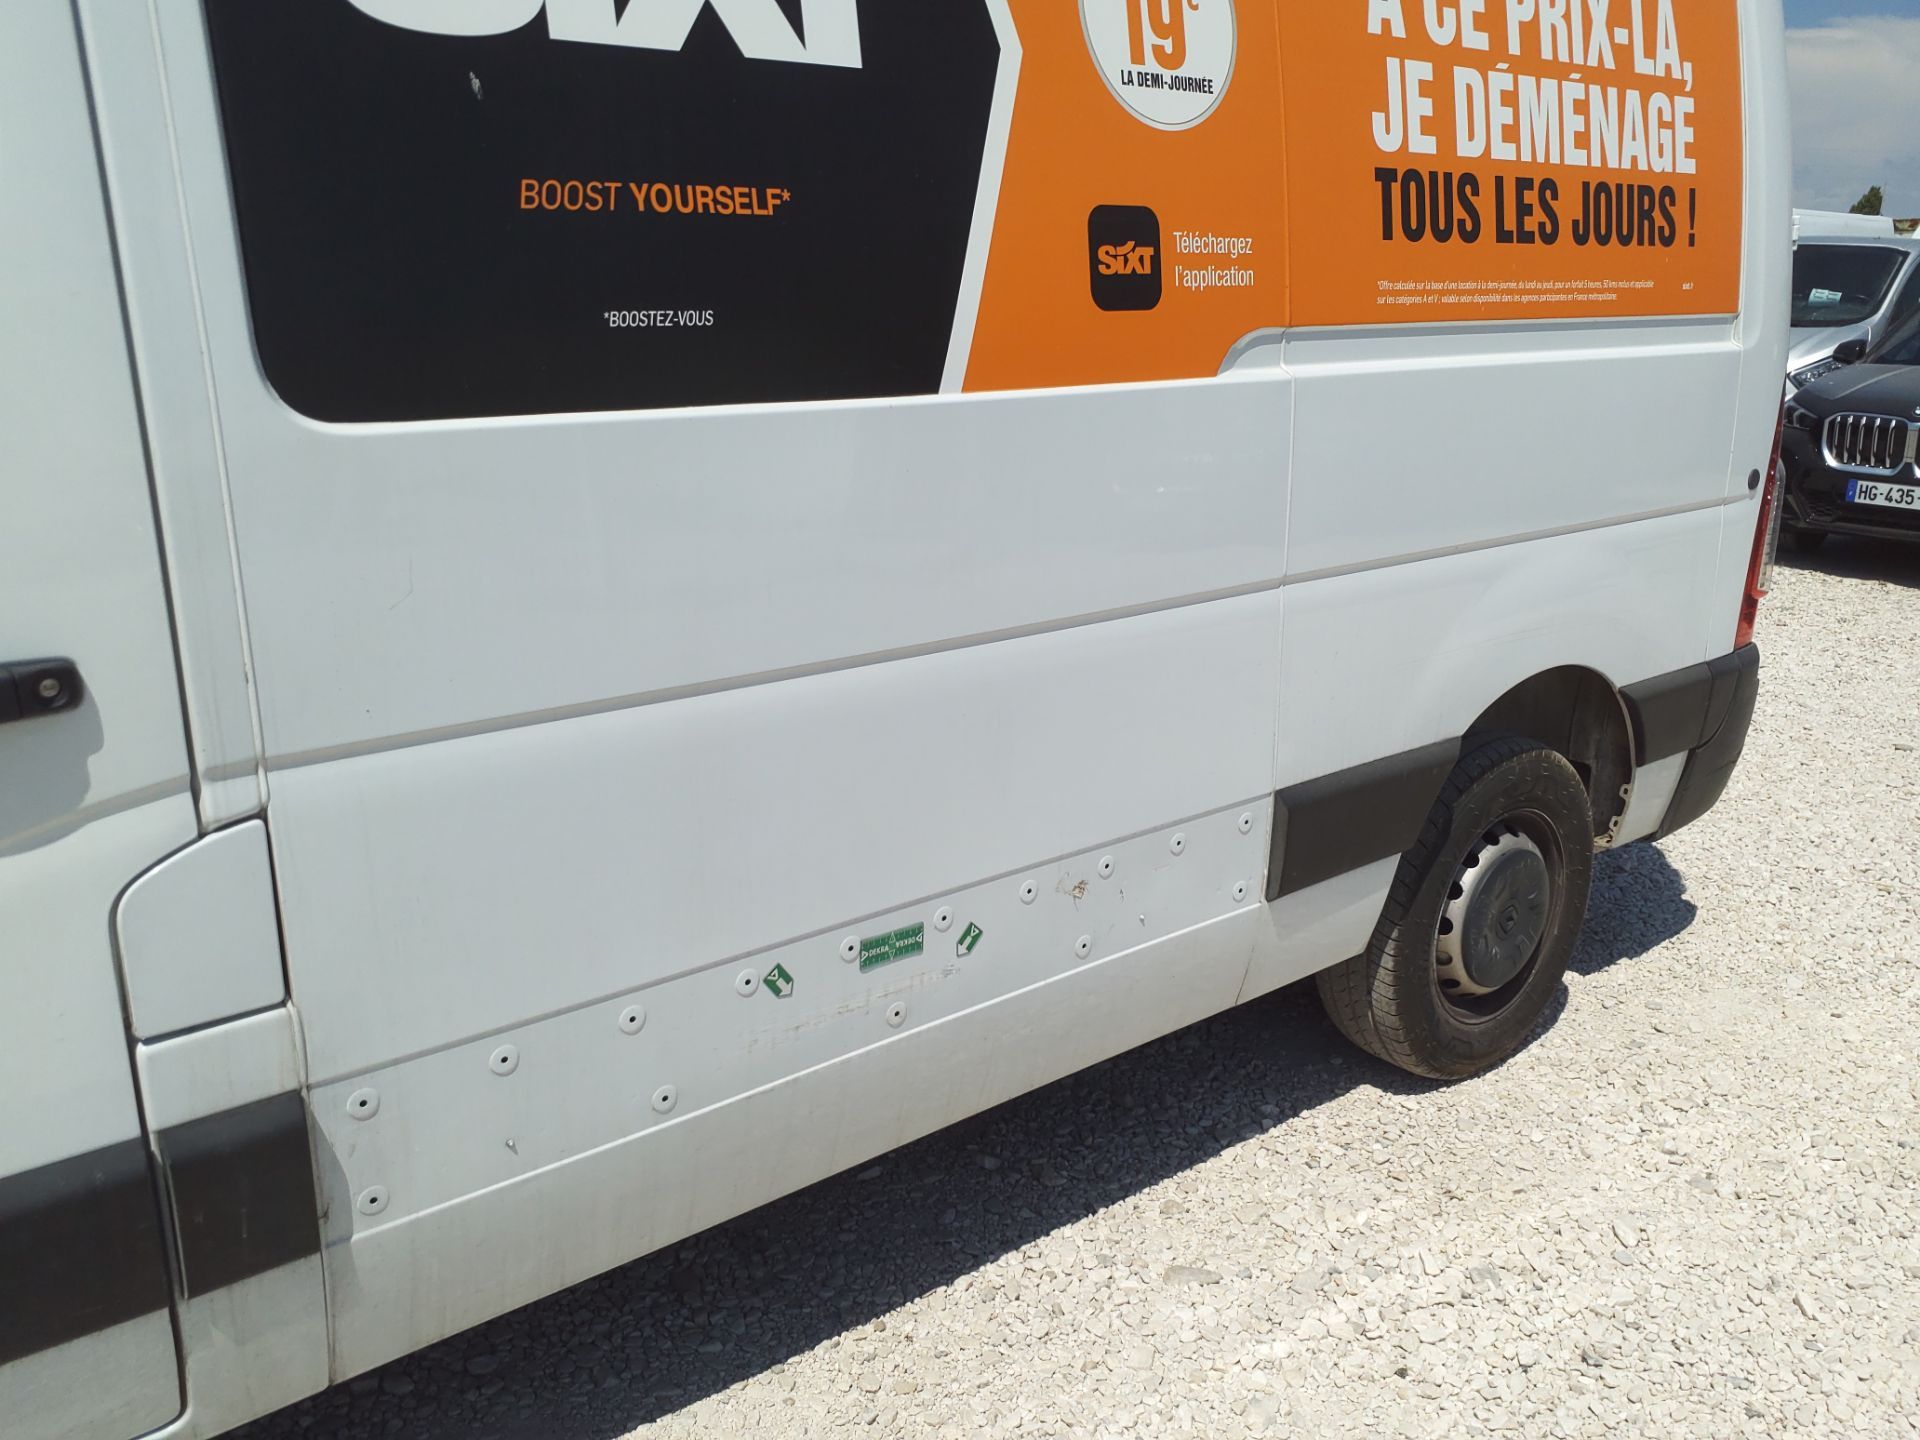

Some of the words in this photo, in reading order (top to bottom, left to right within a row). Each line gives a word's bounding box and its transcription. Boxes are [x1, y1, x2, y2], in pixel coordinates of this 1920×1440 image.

[1121, 69, 1134, 87] LA
[1137, 71, 1214, 95] DEMI-JOURNÉE
[1371, 55, 1437, 155] JE
[1453, 62, 1697, 175] DÉMÉNAGE
[520, 179, 622, 211] BOOST
[1374, 166, 1481, 245] TOUS
[1494, 175, 1559, 246] LES
[1572, 180, 1676, 247] JOURS
[1687, 187, 1697, 247] !
[1173, 231, 1253, 259] Téléchargez
[1175, 266, 1254, 291] l'application
